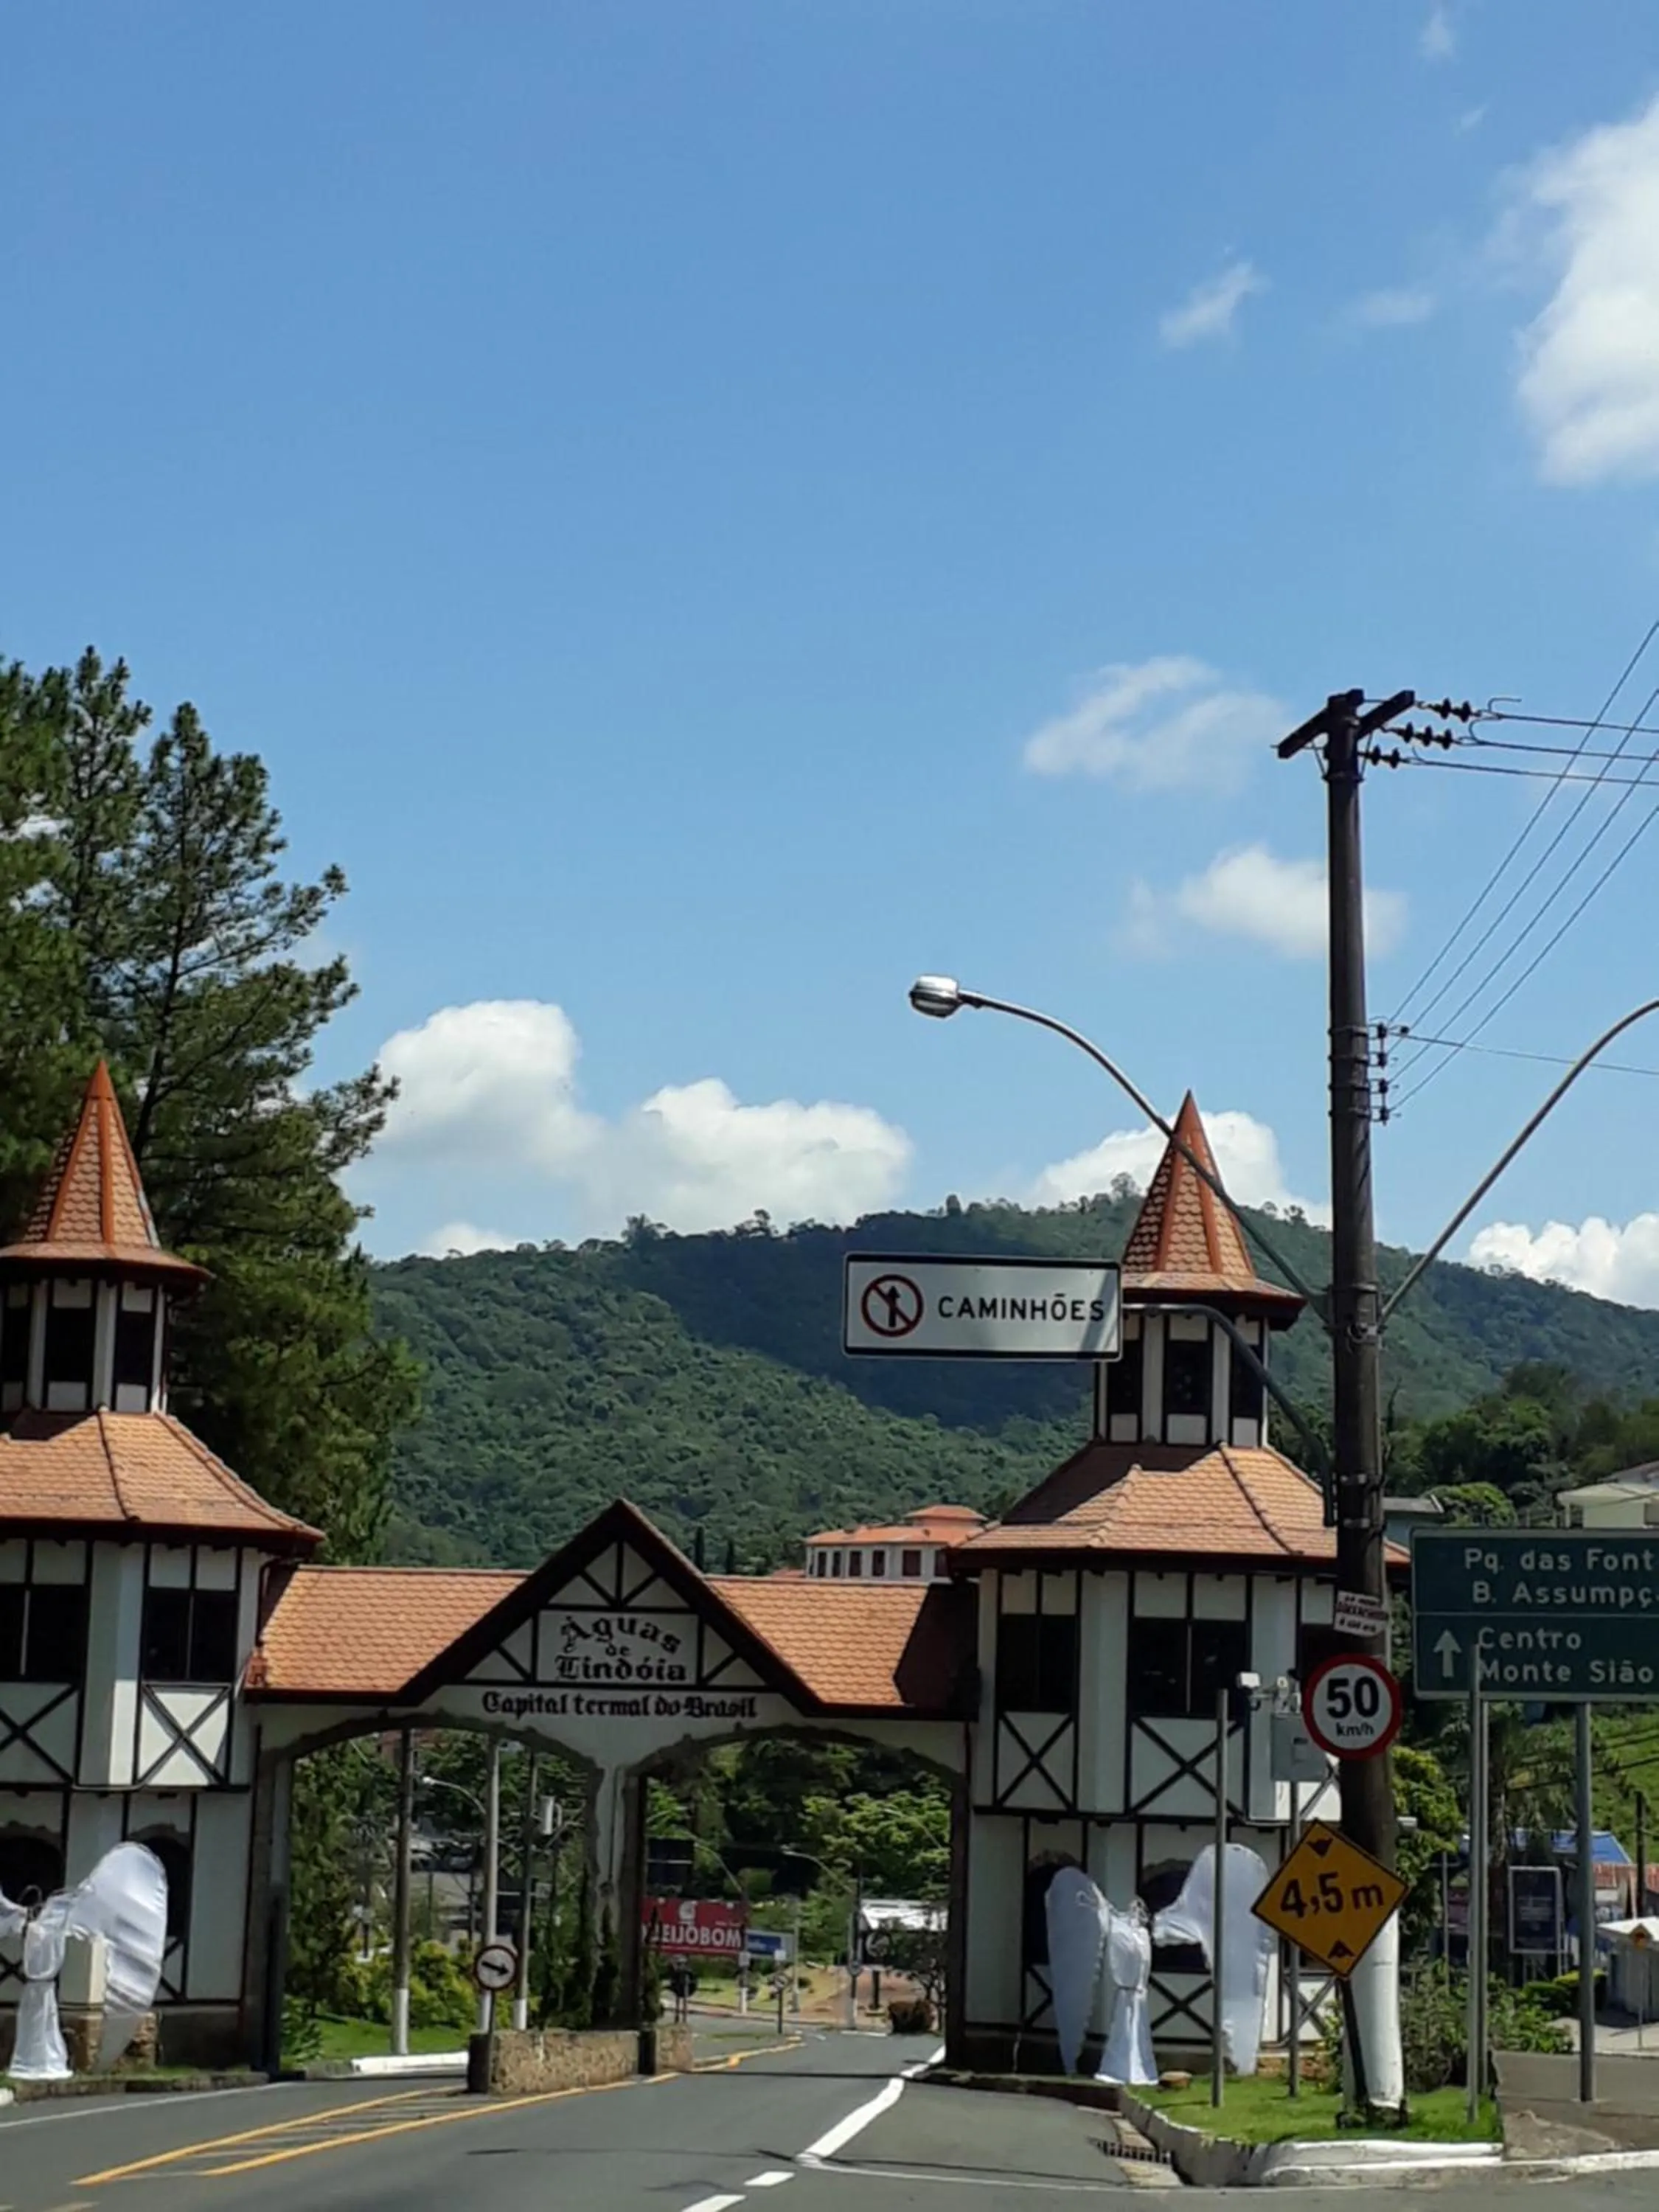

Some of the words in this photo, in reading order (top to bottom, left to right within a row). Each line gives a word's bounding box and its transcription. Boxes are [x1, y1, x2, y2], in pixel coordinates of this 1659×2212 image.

[938, 1293, 1105, 1322] CAMINHÕES
[1464, 1548, 1504, 1574] Pq.
[1520, 1549, 1571, 1571] das
[1472, 1581, 1496, 1604] B.
[1512, 1581, 1659, 1608] Assumpç
[605, 1642, 633, 1657] de
[1478, 1627, 1582, 1649] Centro
[554, 1655, 687, 1681] Lindóia
[1478, 1659, 1572, 1682] Monte
[1589, 1659, 1654, 1683] Sião
[481, 1691, 568, 1720] Capital
[575, 1694, 650, 1717] termal
[654, 1694, 680, 1716] do
[683, 1695, 758, 1719] Brasil
[1326, 1675, 1380, 1719] 50
[1336, 1722, 1374, 1736] km/h
[1280, 1871, 1344, 1919] 4,5
[1351, 1883, 1385, 1910] m
